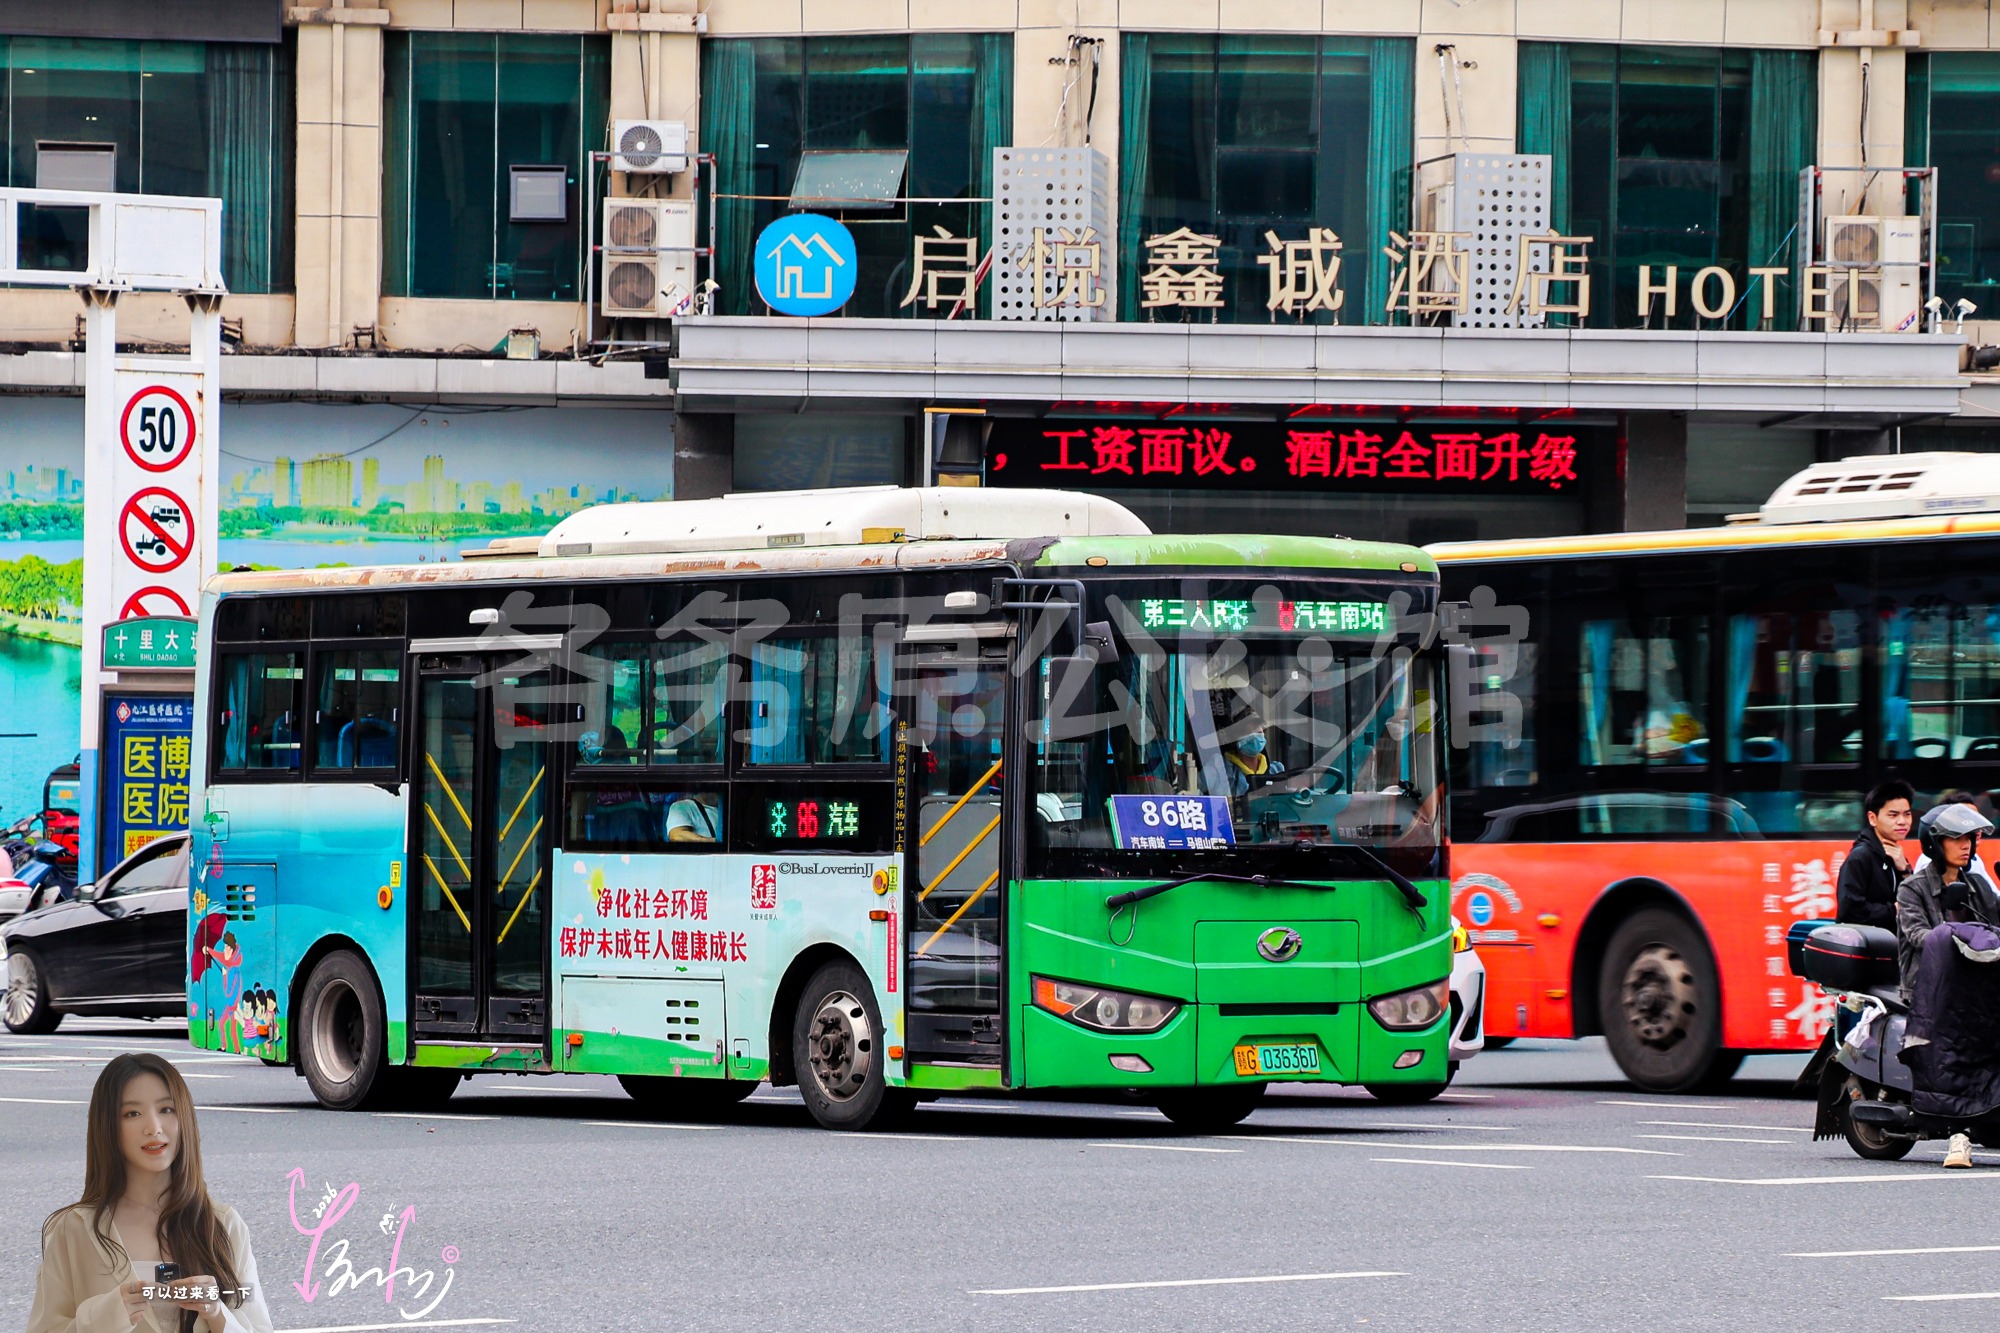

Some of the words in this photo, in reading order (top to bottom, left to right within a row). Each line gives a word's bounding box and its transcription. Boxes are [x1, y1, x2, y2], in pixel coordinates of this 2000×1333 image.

[899, 225, 1594, 318] 启悦鑫诚酒店
[1638, 264, 1879, 319] HOTEL
[139, 407, 175, 453] 50
[1294, 601, 1384, 629] 汽车南站
[124, 736, 191, 779] 医博
[124, 782, 189, 825] 医院
[797, 802, 818, 838] 86
[828, 802, 859, 836] 汽车
[1141, 799, 1207, 831] 86路
[596, 888, 708, 921] 净化社会环境
[559, 926, 748, 962] 保护未成年人健康成长
